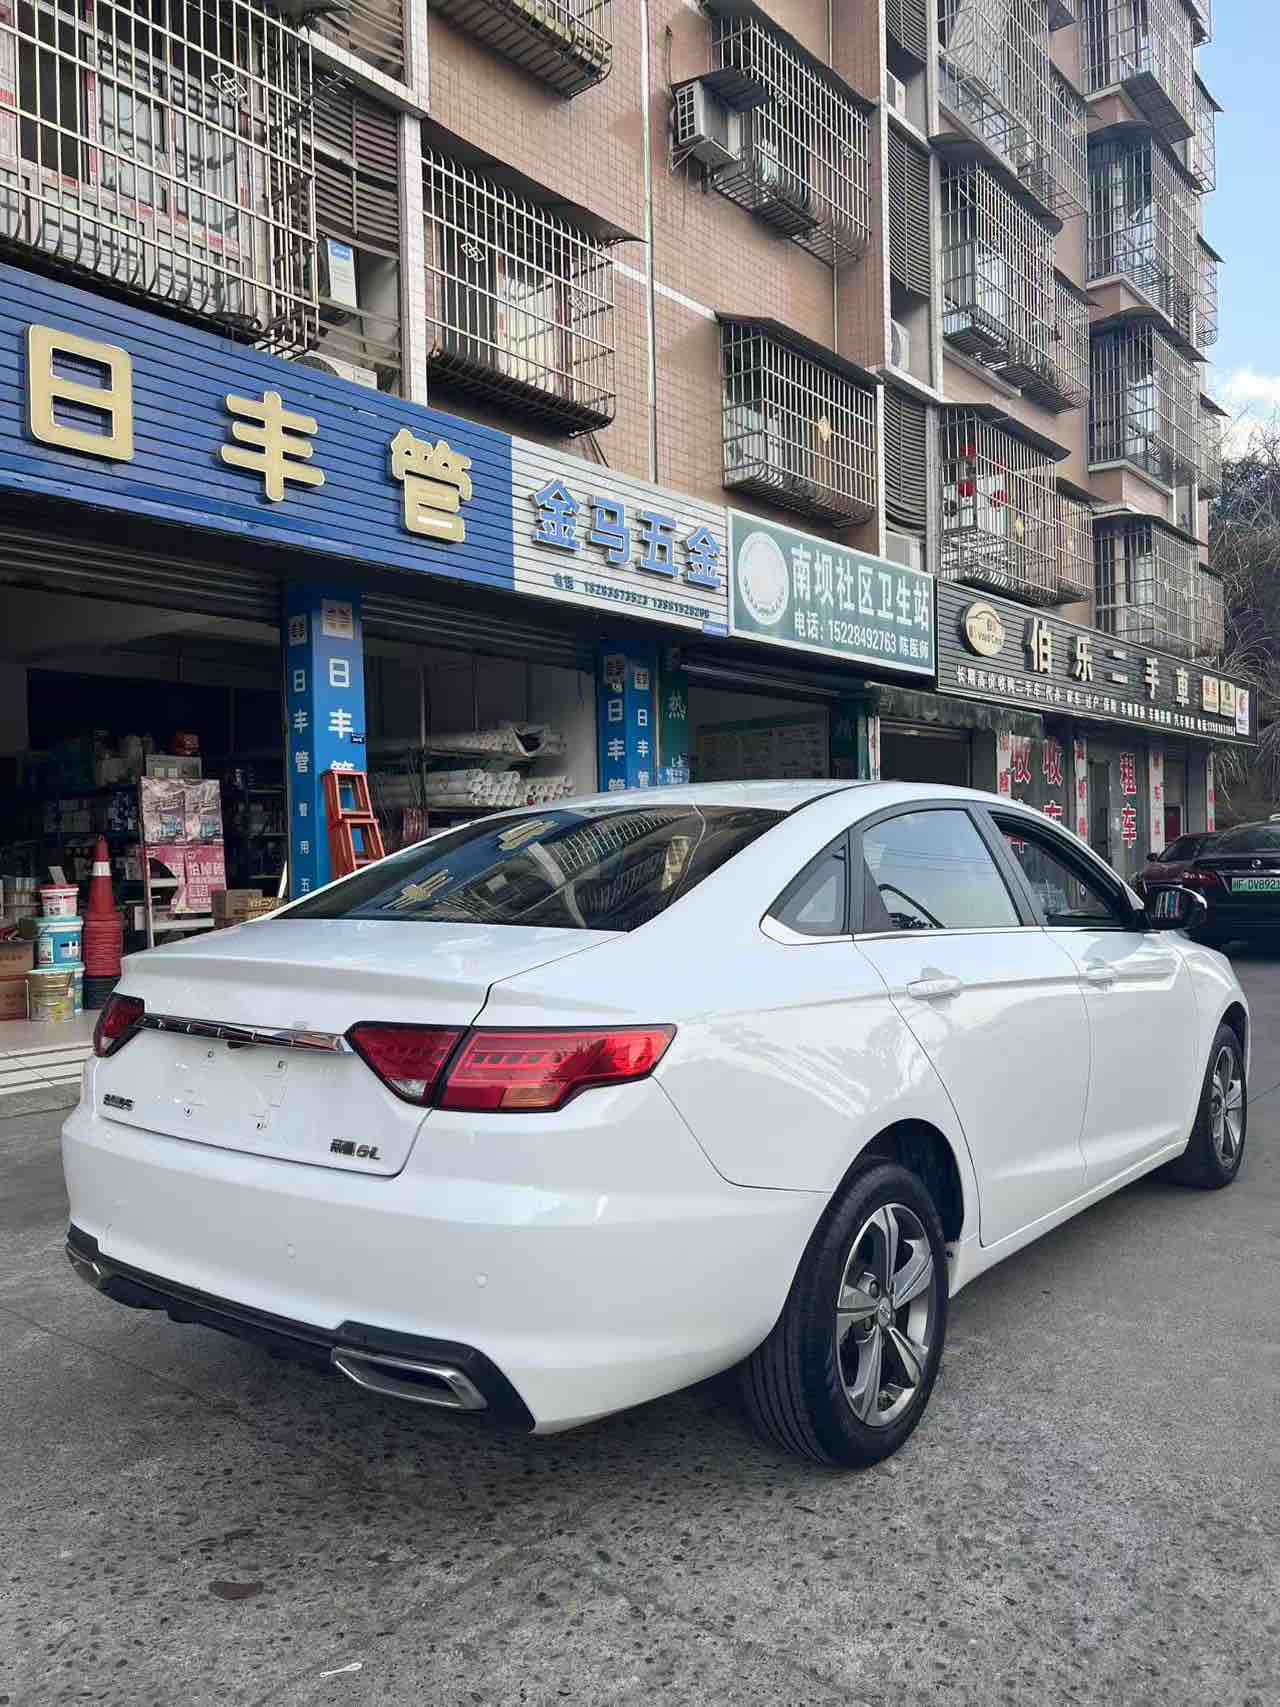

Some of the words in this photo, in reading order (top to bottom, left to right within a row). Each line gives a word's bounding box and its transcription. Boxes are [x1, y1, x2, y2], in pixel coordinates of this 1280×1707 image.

[25, 324, 473, 544] 日丰管
[530, 479, 721, 588] 金马五金
[791, 543, 930, 631] 南坝社区卫生站
[293, 669, 309, 774] 日丰管
[1119, 752, 1137, 849] 租车
